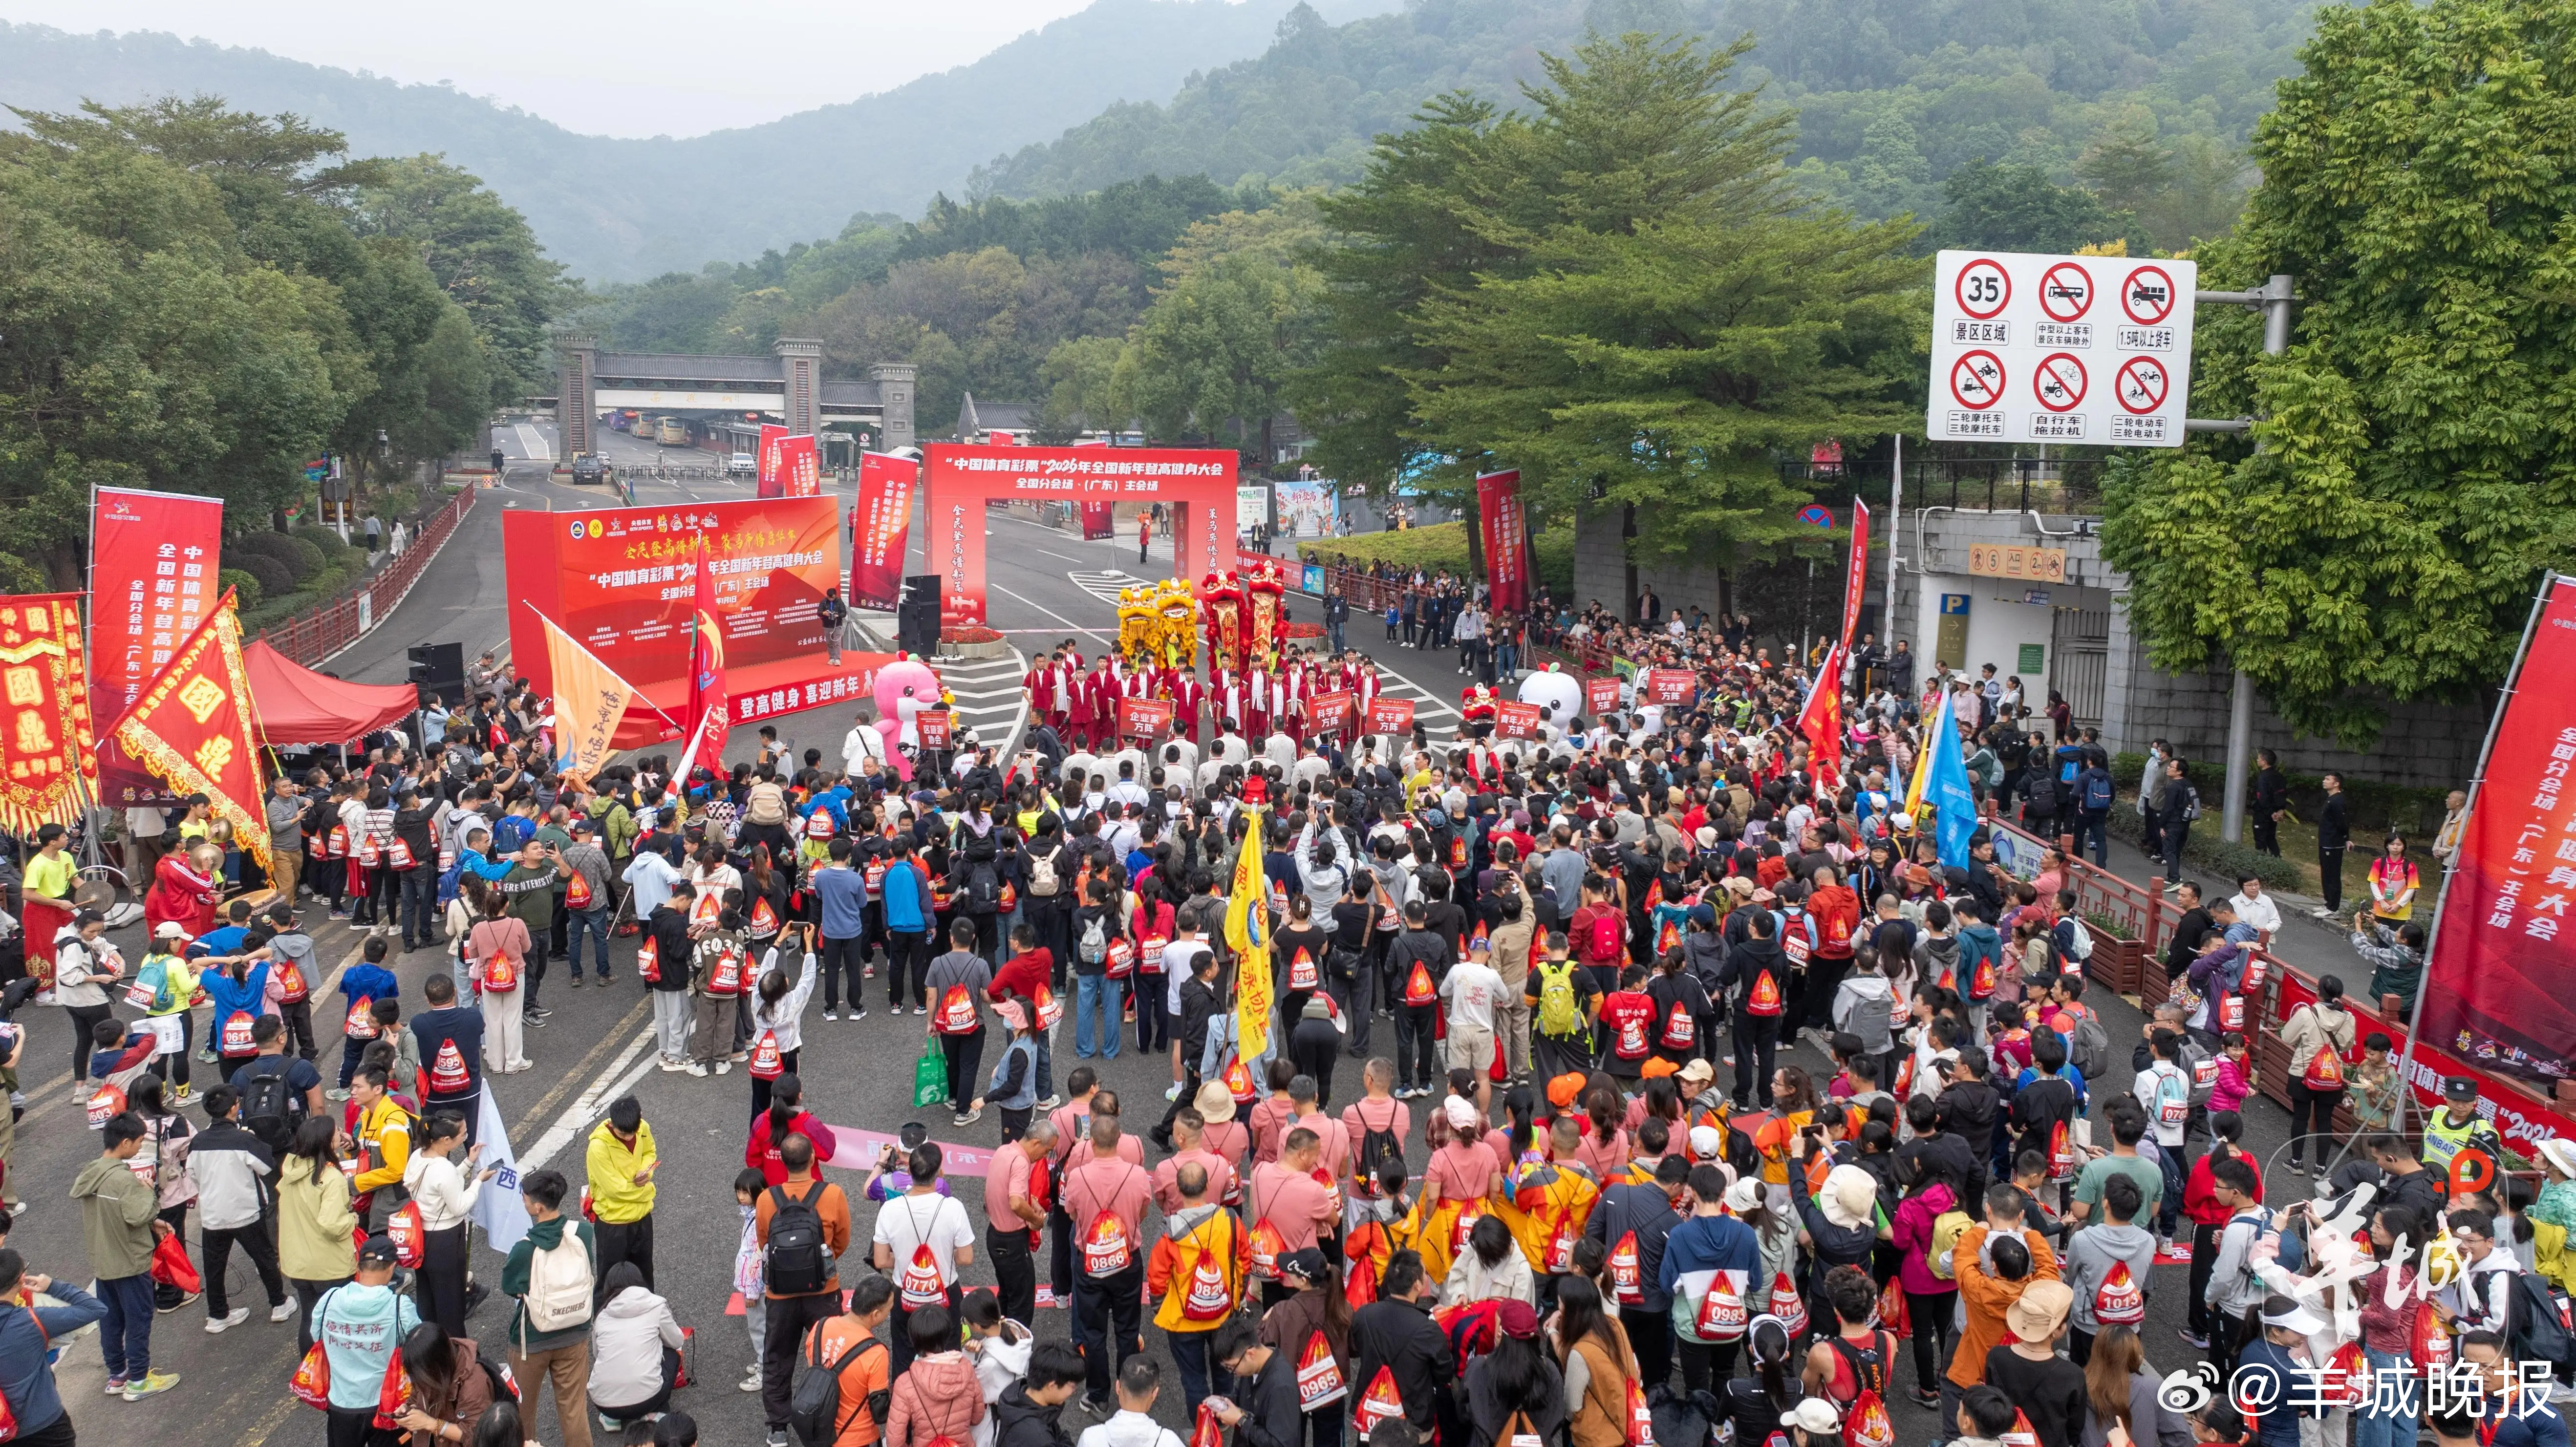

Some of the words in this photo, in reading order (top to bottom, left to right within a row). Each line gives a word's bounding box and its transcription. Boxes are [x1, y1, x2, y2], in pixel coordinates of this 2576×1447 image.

[1968, 277, 1998, 302] 35
[1956, 323, 2006, 342] 景区区域
[2038, 325, 2090, 336] 中型以上客车
[2038, 335, 2089, 346] 景区车辆除外
[2120, 330, 2171, 348] 1.5吨以上货车
[1951, 413, 2001, 423] 二轮摩托车
[2037, 416, 2081, 426] 自行车
[2114, 418, 2164, 428] 二轮电动车
[1949, 424, 2001, 434] 三轮摩托车
[2034, 426, 2081, 436] 拖拉机
[2113, 428, 2163, 438] 三轮电动车
[1124, 480, 1159, 491] 主会场
[891, 482, 907, 533] 中国体育彩票
[875, 480, 895, 567] 全国新年登高健身大会
[1991, 555, 1996, 567] 5
[2009, 553, 2020, 562] 入口
[745, 576, 769, 589] 主会场
[1946, 596, 1963, 613] P
[1657, 682, 1685, 692] 艺术家
[741, 689, 799, 719] 登高健身
[805, 676, 859, 704] 喜迎新年
[1661, 692, 1680, 701] 方阵
[4, 665, 54, 753] 國鼎
[1316, 705, 1343, 718] 科学家
[1130, 711, 1160, 724] 企业家
[1321, 716, 1339, 728] 方阵
[1375, 712, 1404, 723] 老干部
[1501, 714, 1535, 727] 青年人才
[1134, 723, 1154, 733] 方阵
[1379, 721, 1398, 732] 方阵
[1507, 725, 1525, 736] 方阵
[1293, 972, 1314, 980] 0215
[130, 988, 150, 1002] 0590
[949, 1012, 972, 1024] 0051
[226, 1030, 252, 1041] 0611
[2426, 1133, 2455, 1155] ANBAO
[1091, 1252, 1124, 1269] 0866
[905, 1276, 936, 1291] 0770
[2104, 1294, 2138, 1307] 1013
[551, 1300, 585, 1317] SKECHERS
[1712, 1306, 1745, 1321] 0983
[1301, 1373, 1337, 1398] 0965
